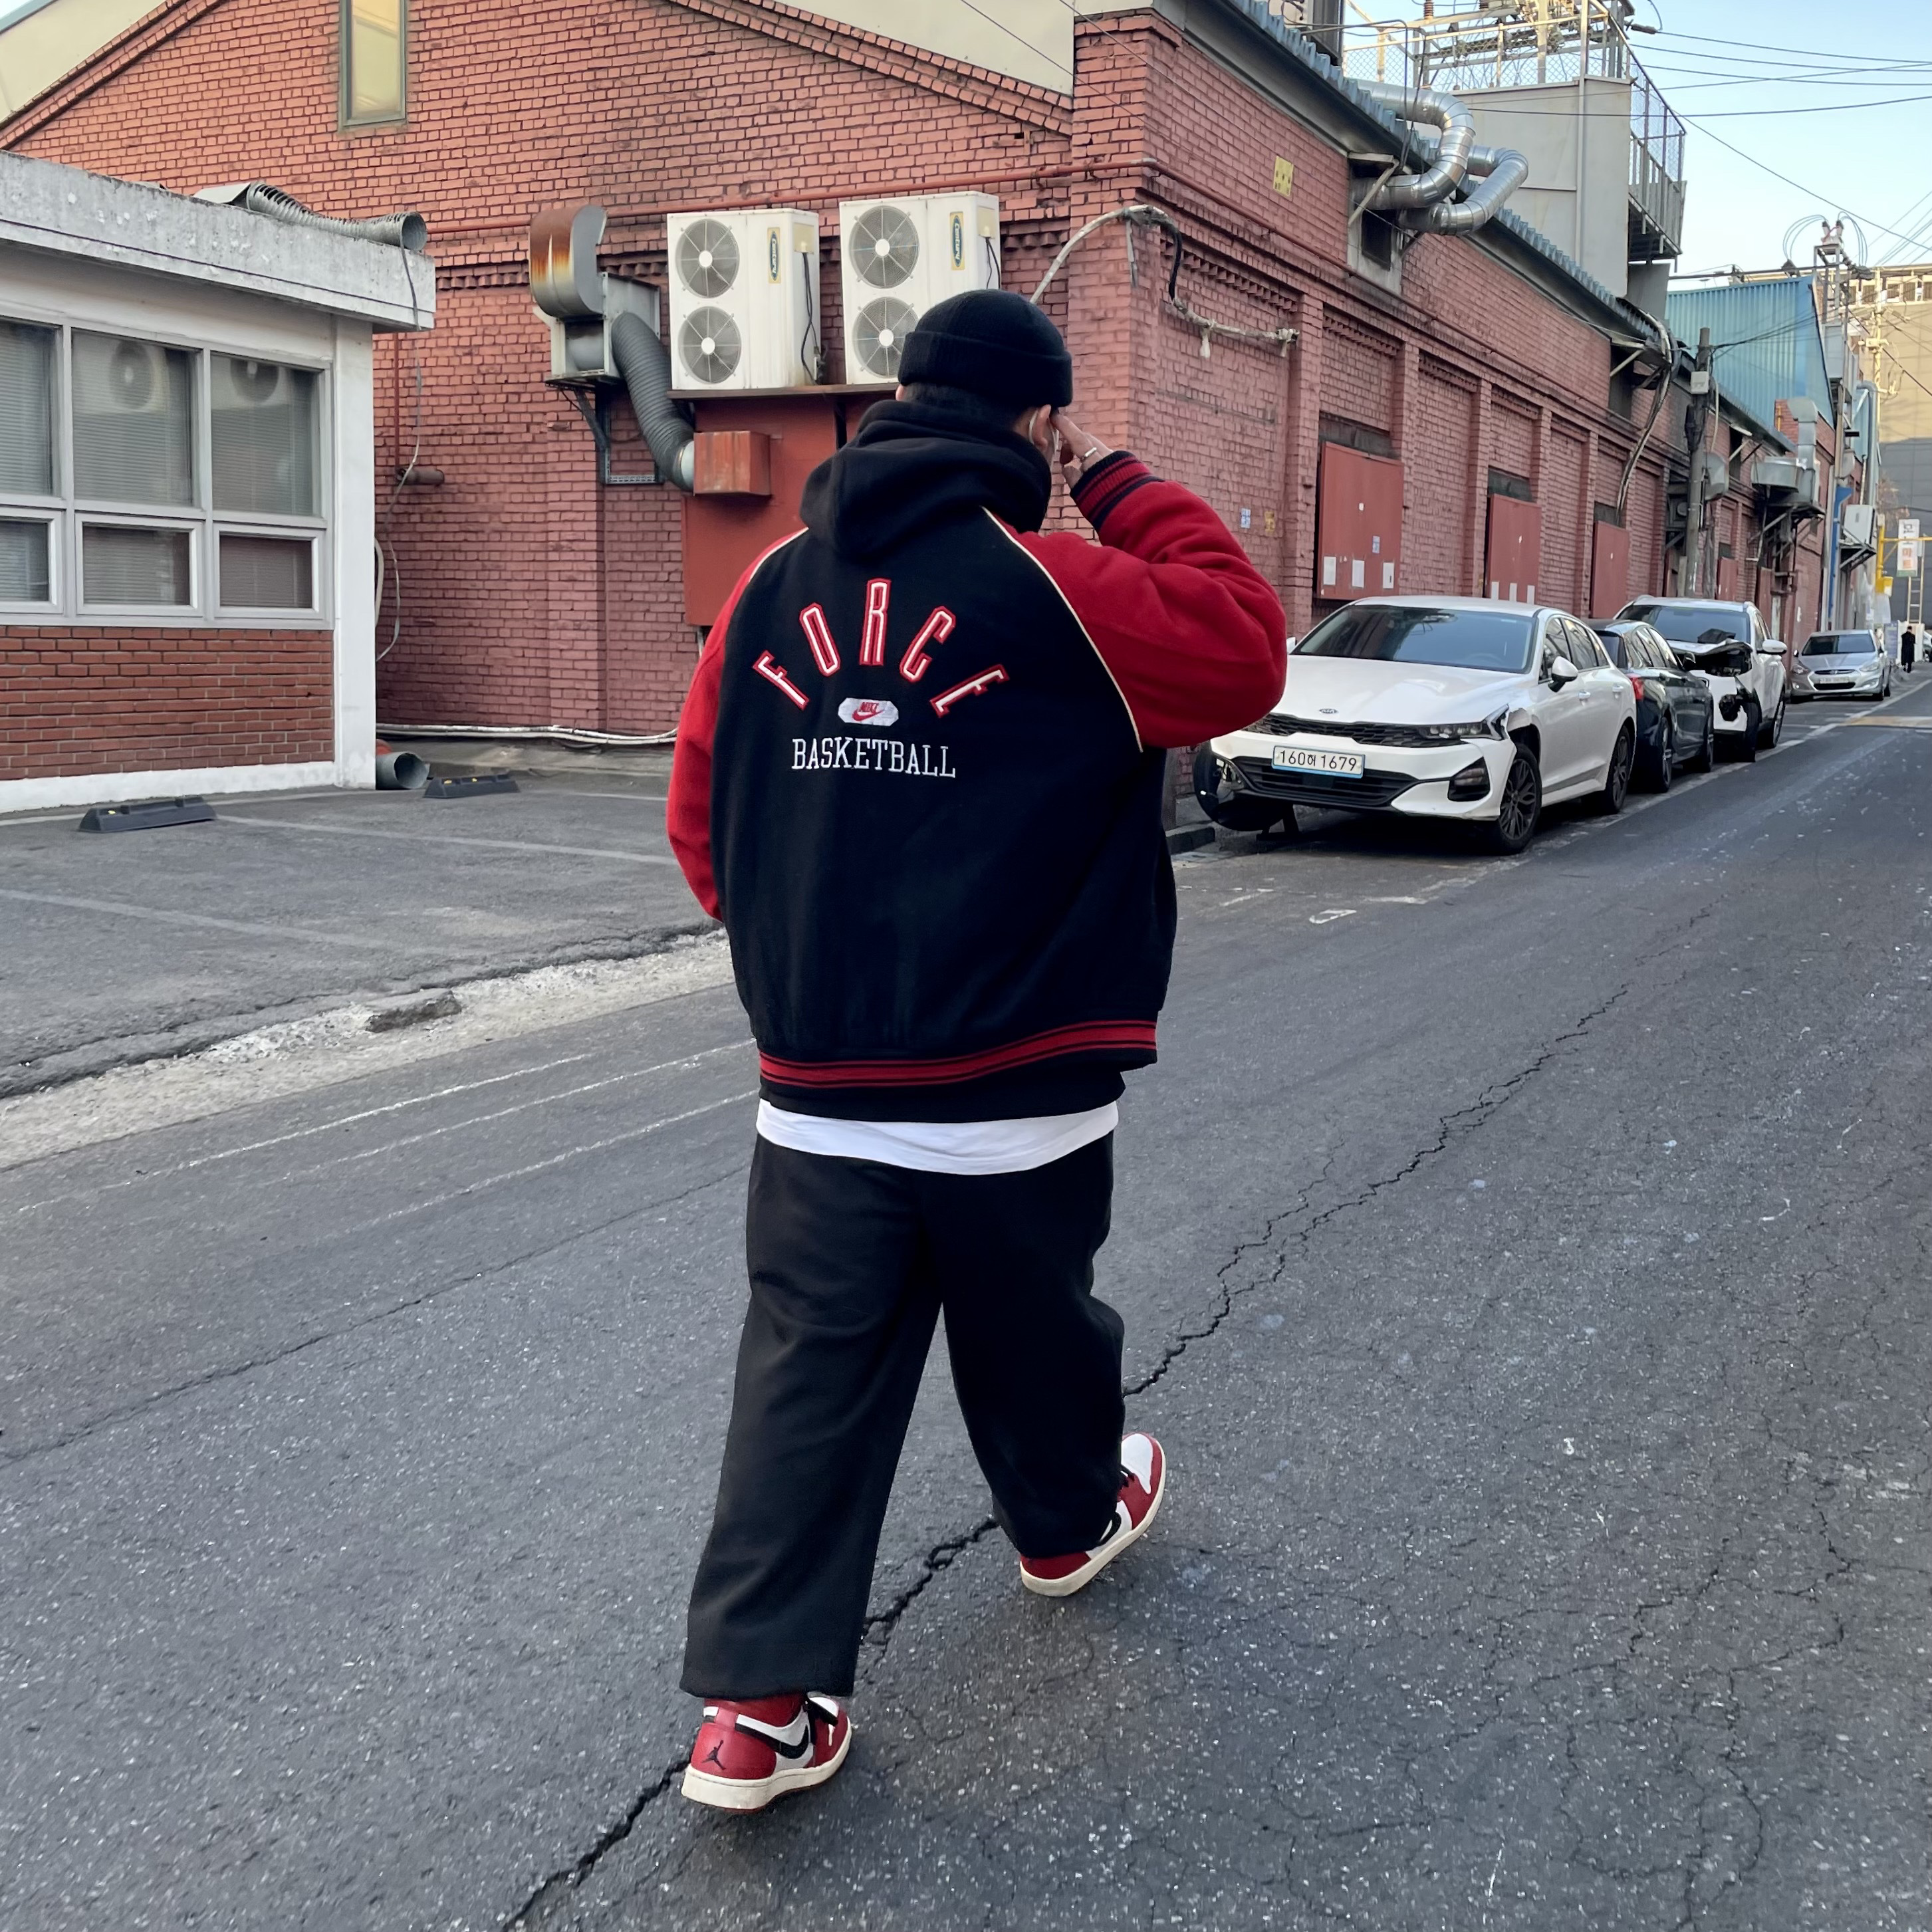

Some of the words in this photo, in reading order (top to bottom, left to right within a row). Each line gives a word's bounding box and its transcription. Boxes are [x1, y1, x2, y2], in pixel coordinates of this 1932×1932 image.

[753, 578, 1010, 718] FORCE
[858, 701, 880, 713] NIKE
[791, 736, 956, 779] BASKETBALL
